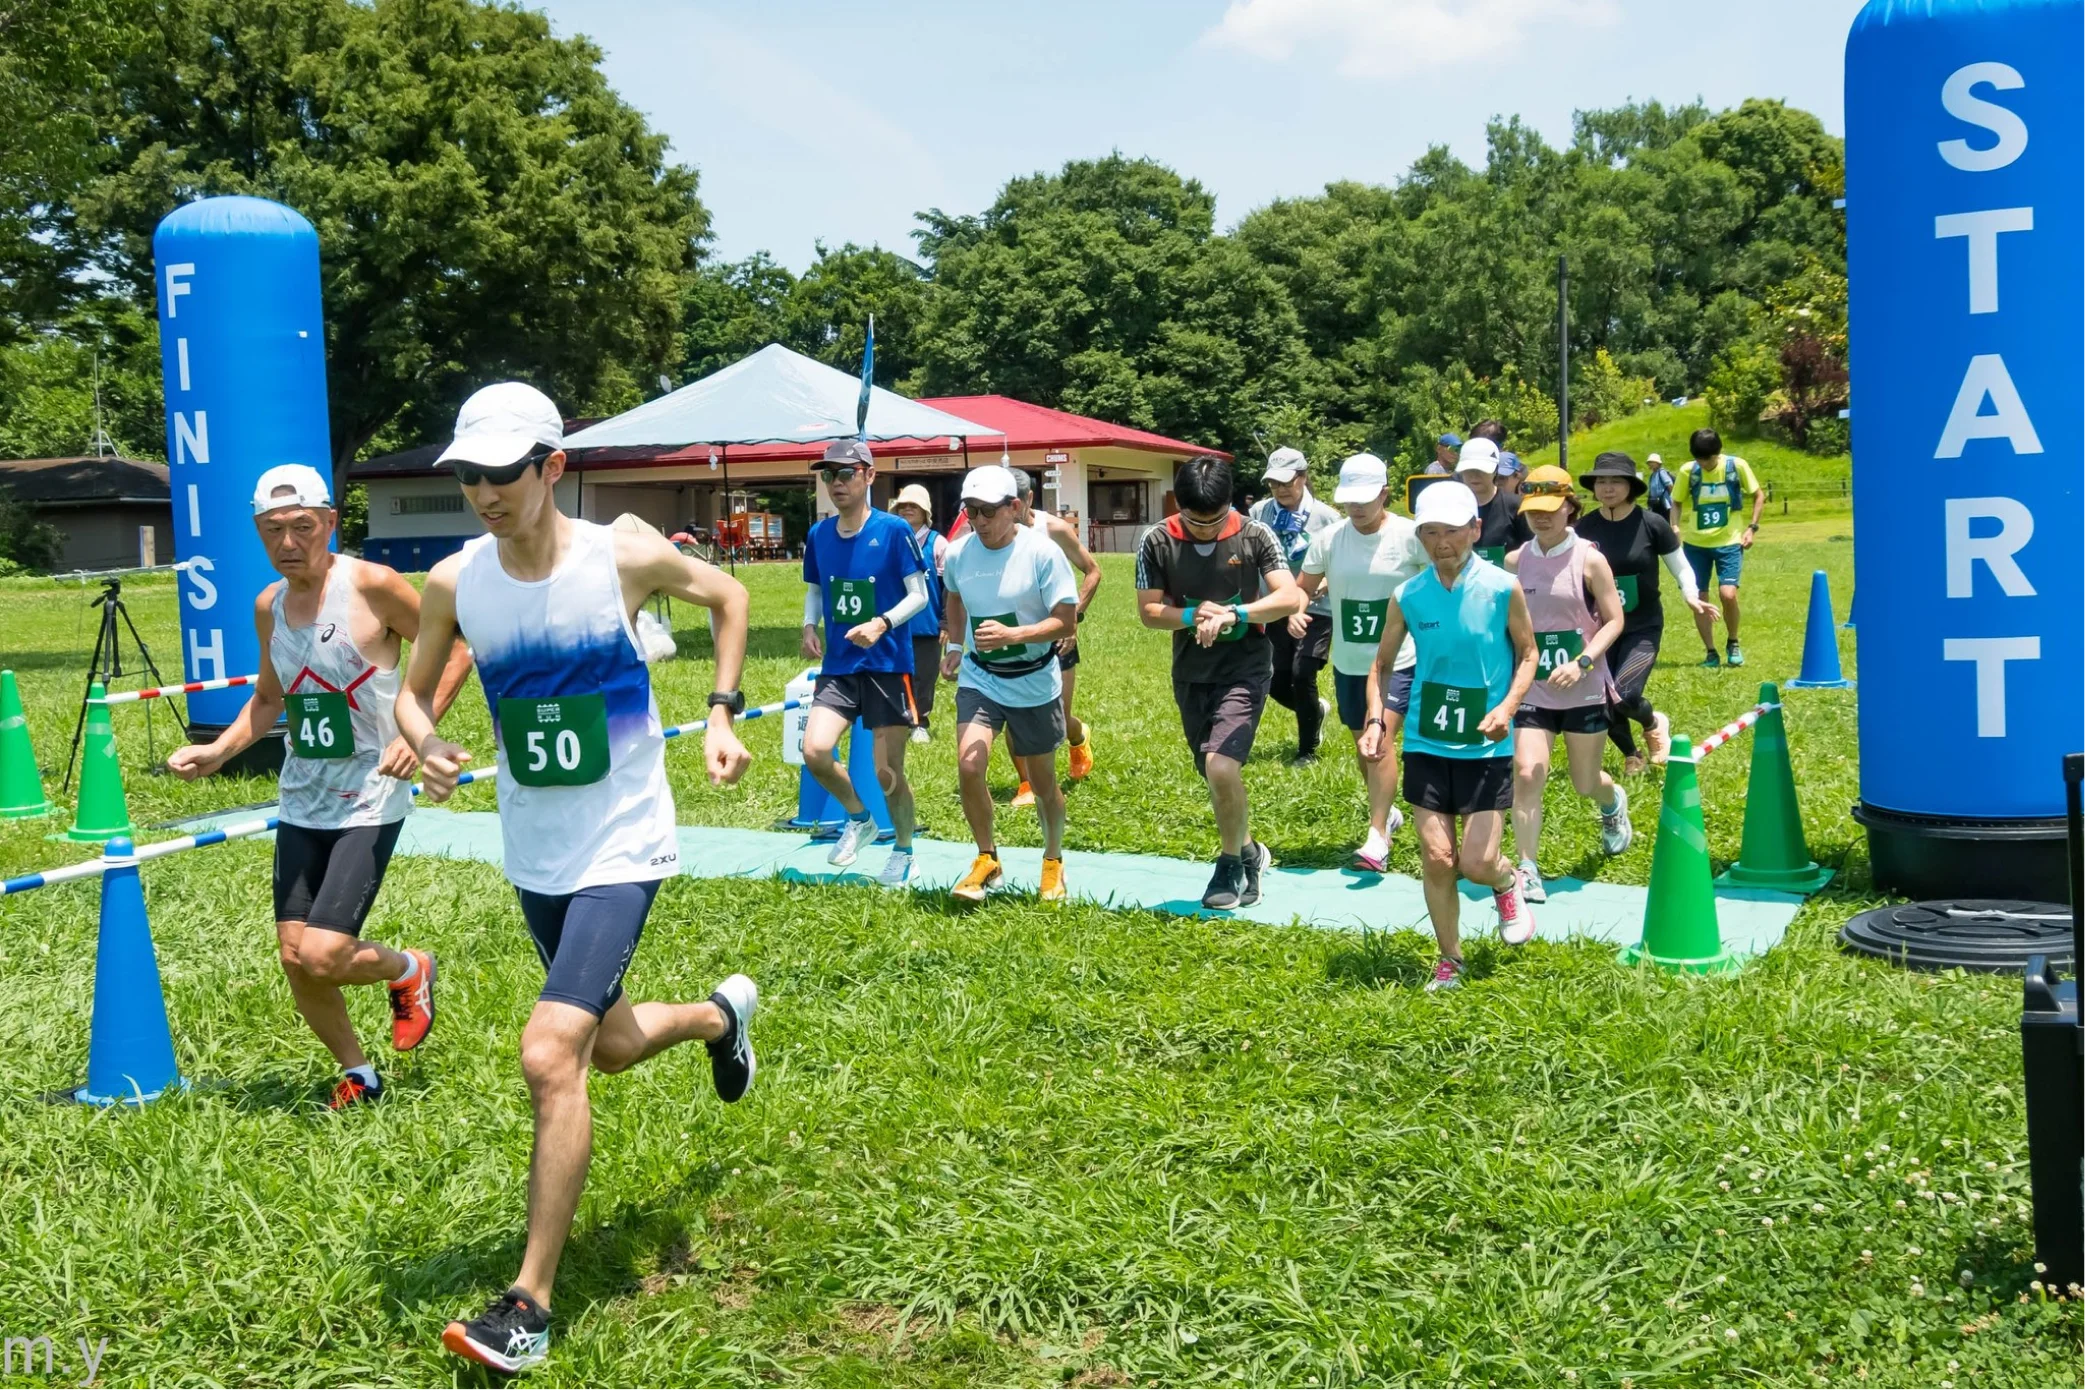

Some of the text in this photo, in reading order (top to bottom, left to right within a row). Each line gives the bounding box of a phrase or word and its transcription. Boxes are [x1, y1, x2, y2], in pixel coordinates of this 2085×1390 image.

[1934, 61, 2045, 739] START
[165, 262, 226, 681] FINISH
[1702, 511, 1721, 526] 39
[836, 594, 862, 616] 49
[1352, 615, 1379, 636] 37
[1539, 647, 1569, 671] 40
[300, 717, 335, 748] 46
[1433, 704, 1466, 734] 41
[527, 729, 581, 772] 50
[650, 853, 677, 866] 2XU
